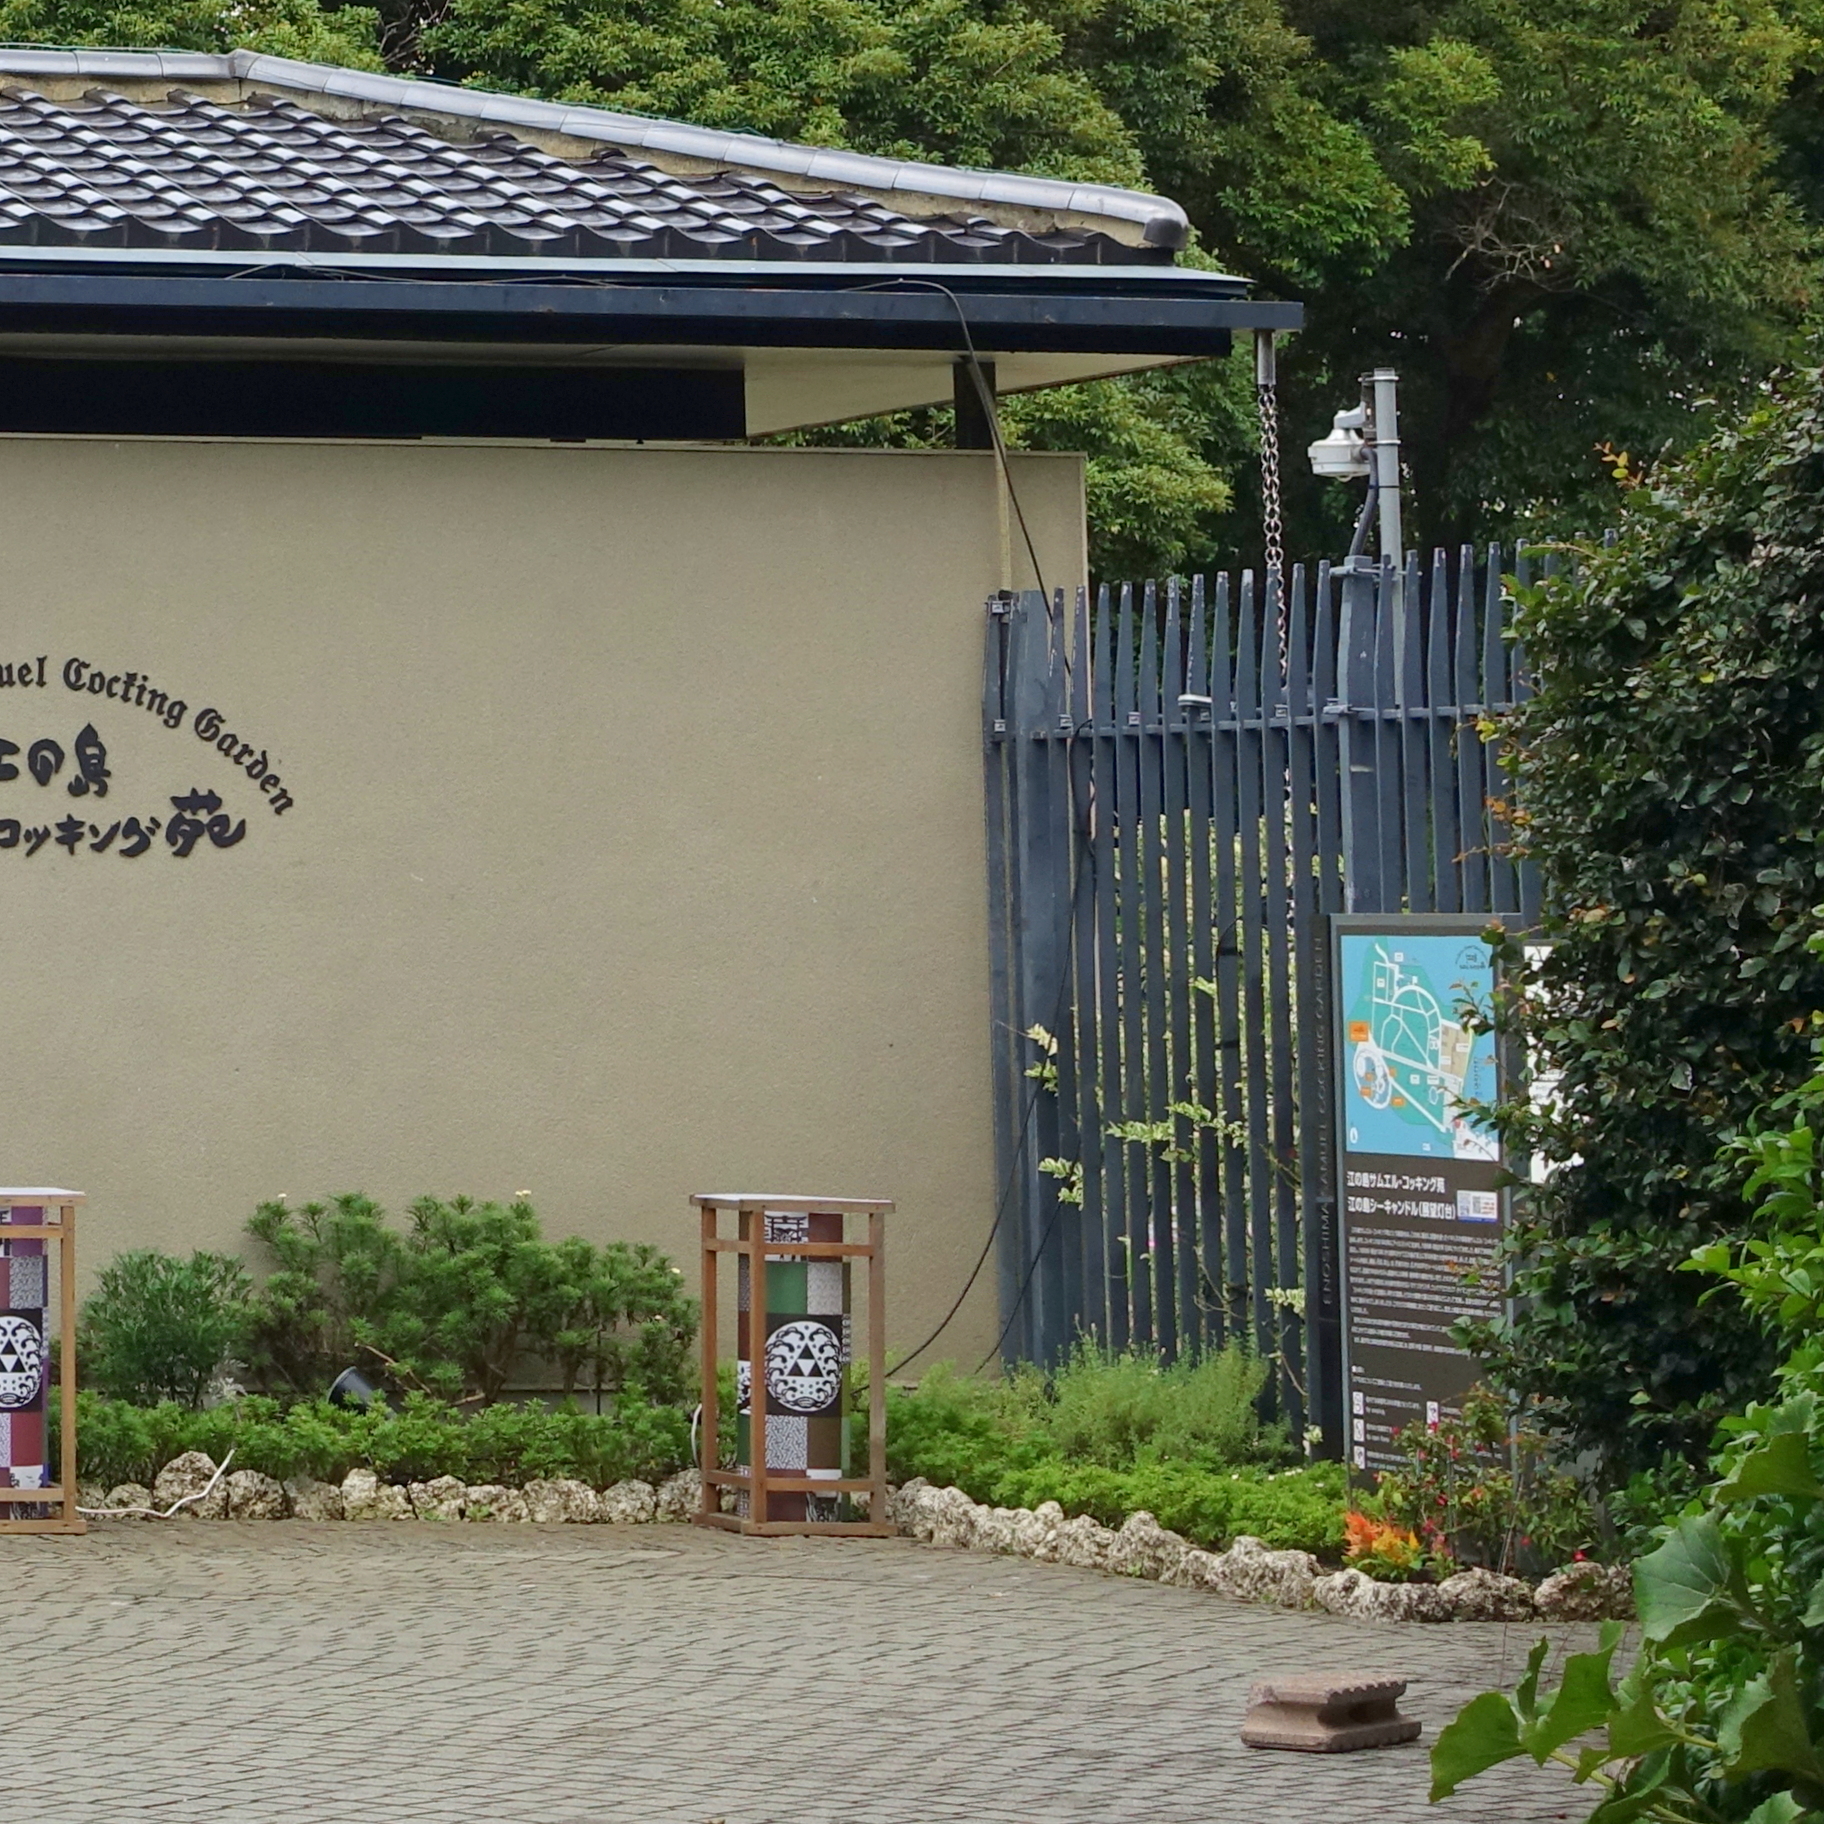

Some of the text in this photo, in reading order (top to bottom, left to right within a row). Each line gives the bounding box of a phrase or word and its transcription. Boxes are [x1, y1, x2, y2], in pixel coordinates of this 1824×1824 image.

[62, 657, 189, 729] Cocking
[193, 706, 296, 817] Garden
[1314, 936, 1325, 1019] GARDEN
[1346, 1171, 1446, 1194] 江の島サムエル・コッキング苑
[1321, 1202, 1332, 1305] ENOSHIMA
